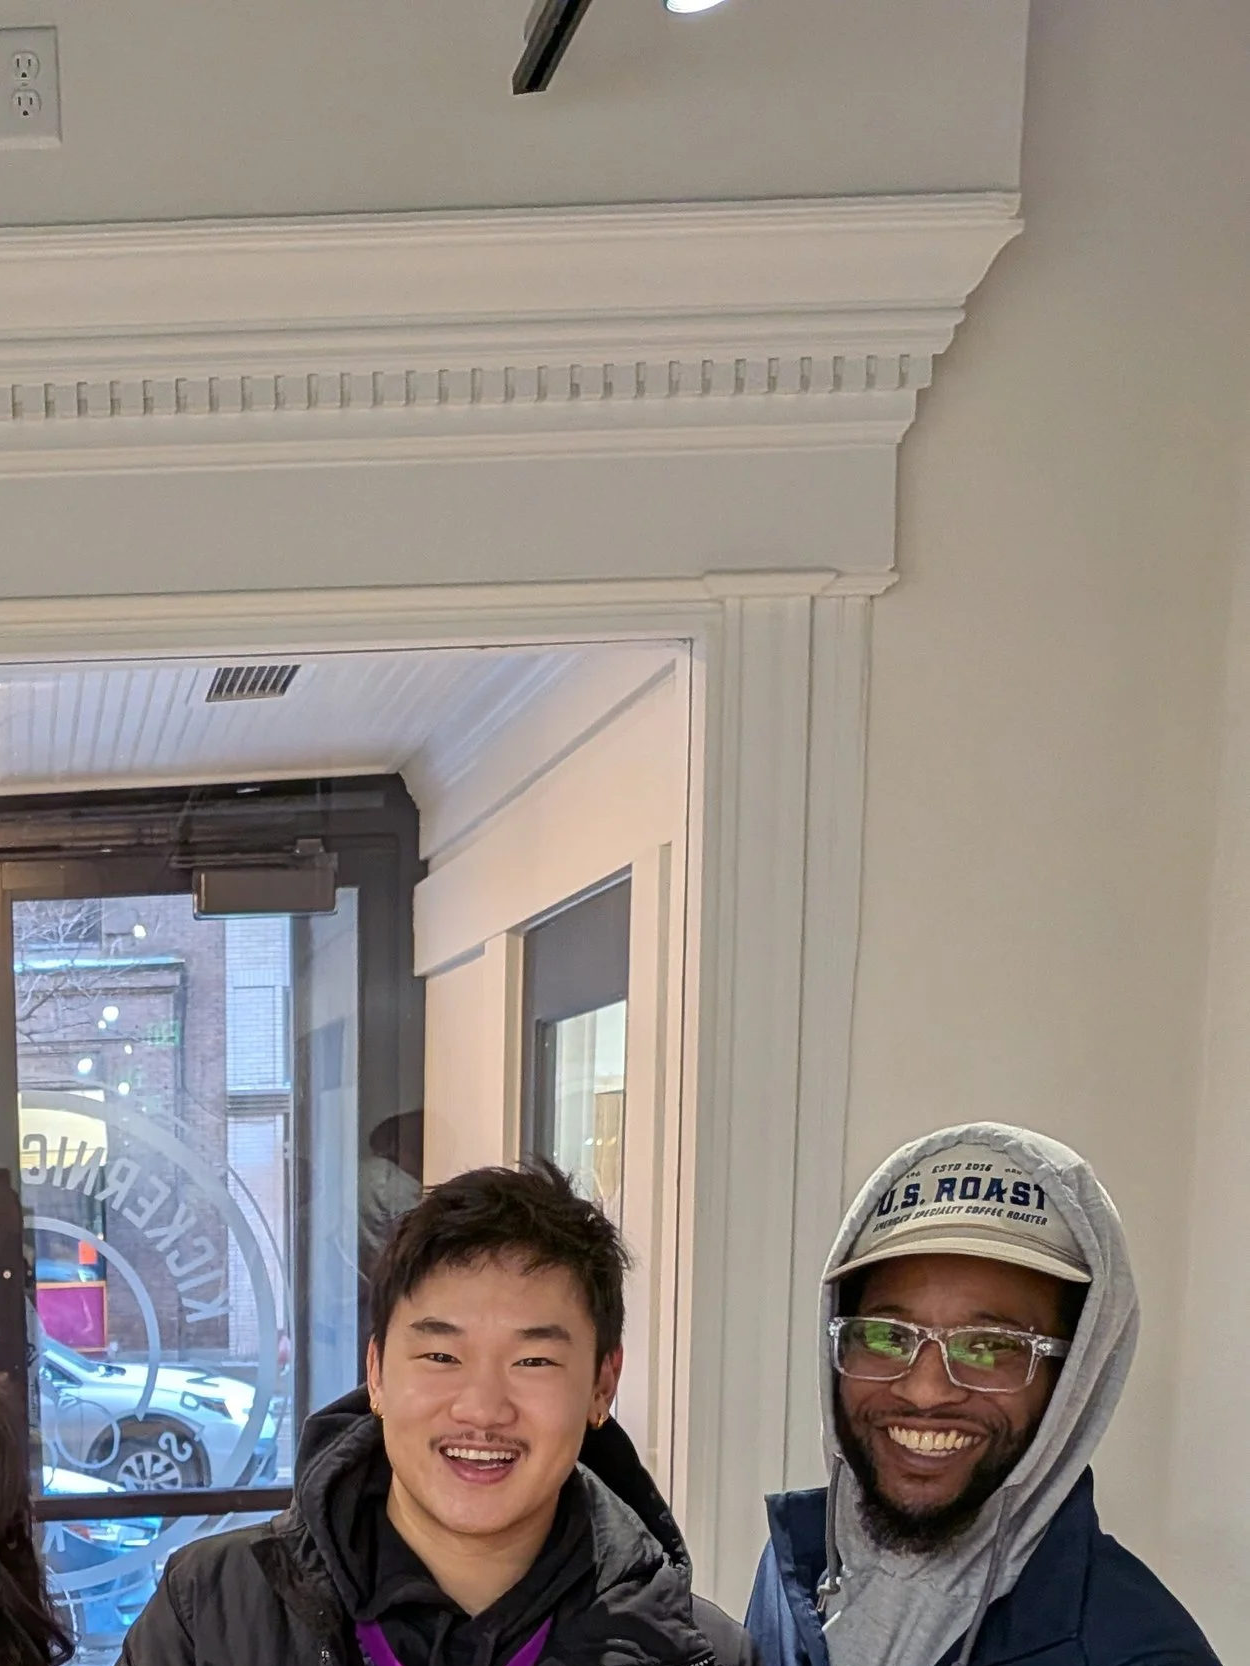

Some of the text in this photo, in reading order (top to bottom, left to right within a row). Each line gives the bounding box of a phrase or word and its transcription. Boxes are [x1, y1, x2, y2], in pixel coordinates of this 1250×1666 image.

[932, 1163, 962, 1174] ESTD
[877, 1176, 1045, 1218] U.S. ROAST
[912, 1205, 963, 1220] SPECIALTY
[965, 1205, 1004, 1218] COFFEE
[1006, 1210, 1048, 1226] ROASTER
